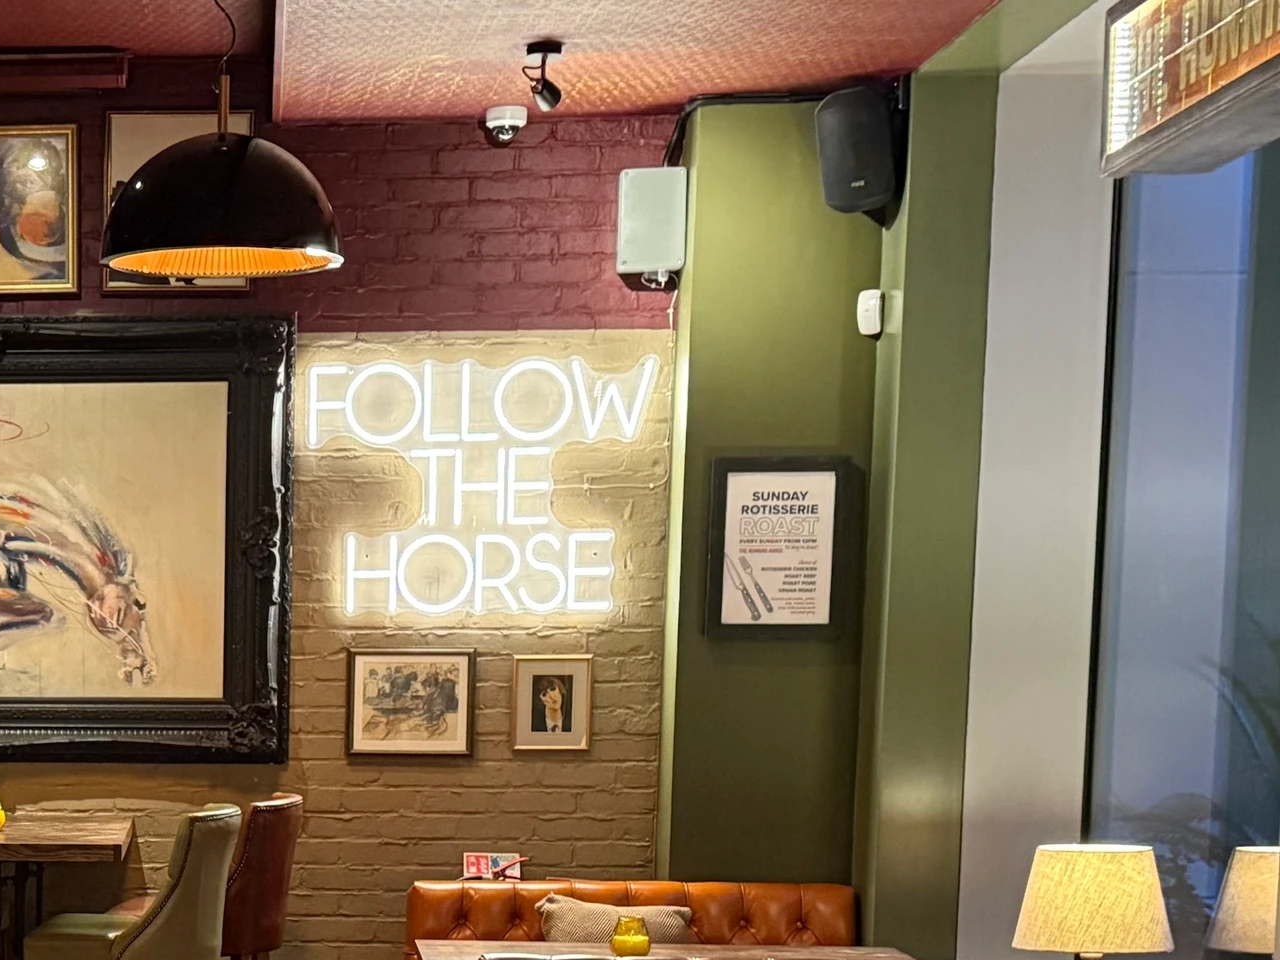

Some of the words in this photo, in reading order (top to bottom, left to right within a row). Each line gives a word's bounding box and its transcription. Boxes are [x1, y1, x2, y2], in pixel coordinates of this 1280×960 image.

[1179, 0, 1280, 92] RUNNI
[308, 356, 656, 446] FOLLOW
[409, 446, 552, 526] THE
[739, 516, 820, 536] ROAST
[740, 504, 819, 515] ROTISSERIE
[752, 491, 809, 502] SUNDAY
[345, 532, 614, 614] HORSE
